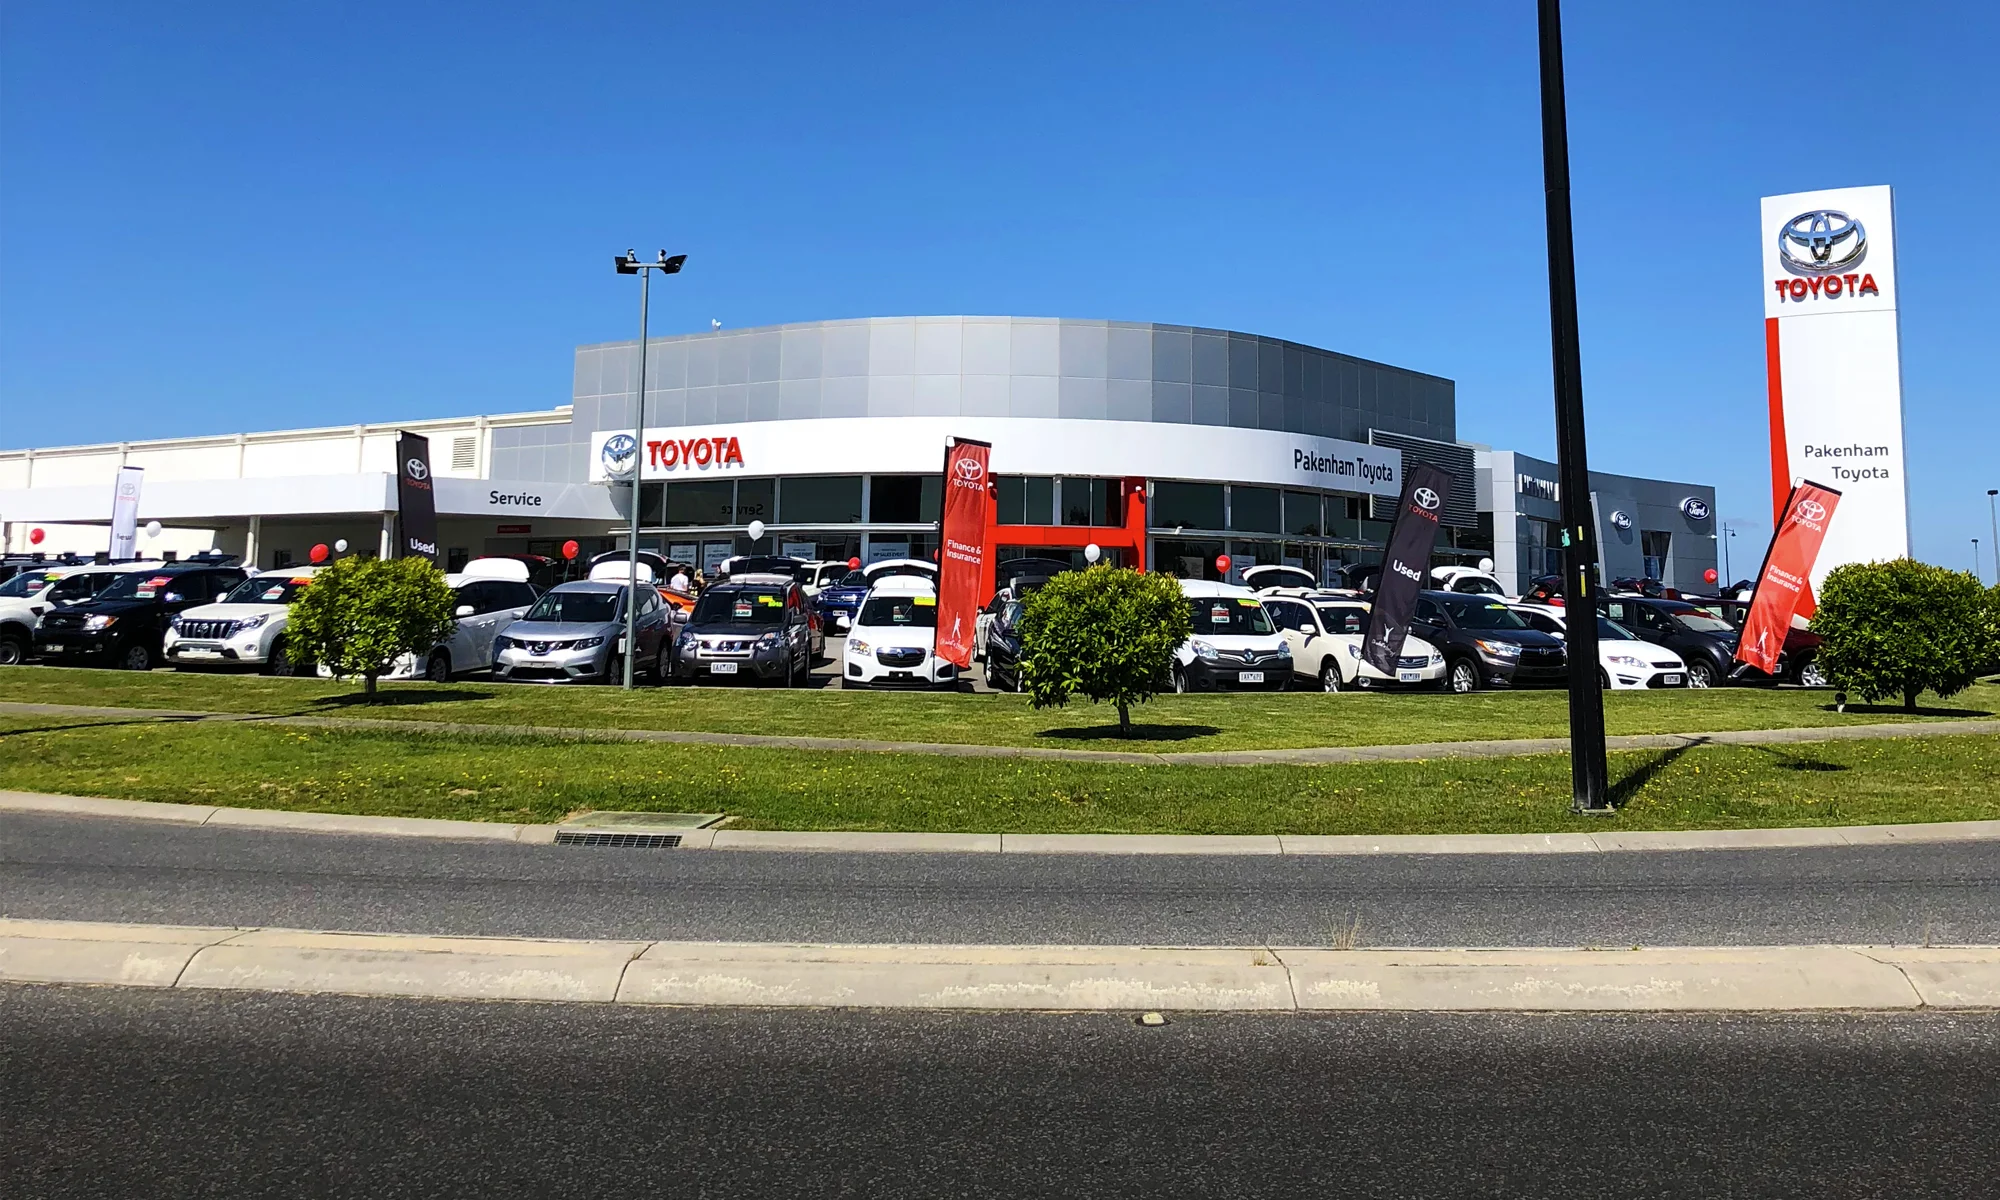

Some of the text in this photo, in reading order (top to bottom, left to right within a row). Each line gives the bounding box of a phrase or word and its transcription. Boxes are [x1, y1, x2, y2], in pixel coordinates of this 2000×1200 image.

[1775, 273, 1879, 300] TOYOTA
[646, 436, 744, 467] TOYOTA
[1804, 443, 1889, 458] Pakenham
[1294, 448, 1393, 485] Pakenham Toyota
[1831, 466, 1890, 483] Toyota
[404, 478, 431, 490] TOYOTA
[953, 478, 985, 492] TOYOTA
[489, 490, 542, 506] Service
[1408, 503, 1439, 523] TOYOTA
[1688, 501, 1706, 517] Ford
[1791, 515, 1822, 532] TOYOTA
[410, 537, 435, 554] Used
[947, 539, 983, 555] Finance &
[946, 548, 982, 565] Insurance
[1393, 558, 1422, 582] Used
[1769, 564, 1795, 581] Finance
[1767, 572, 1800, 592] Insurance
